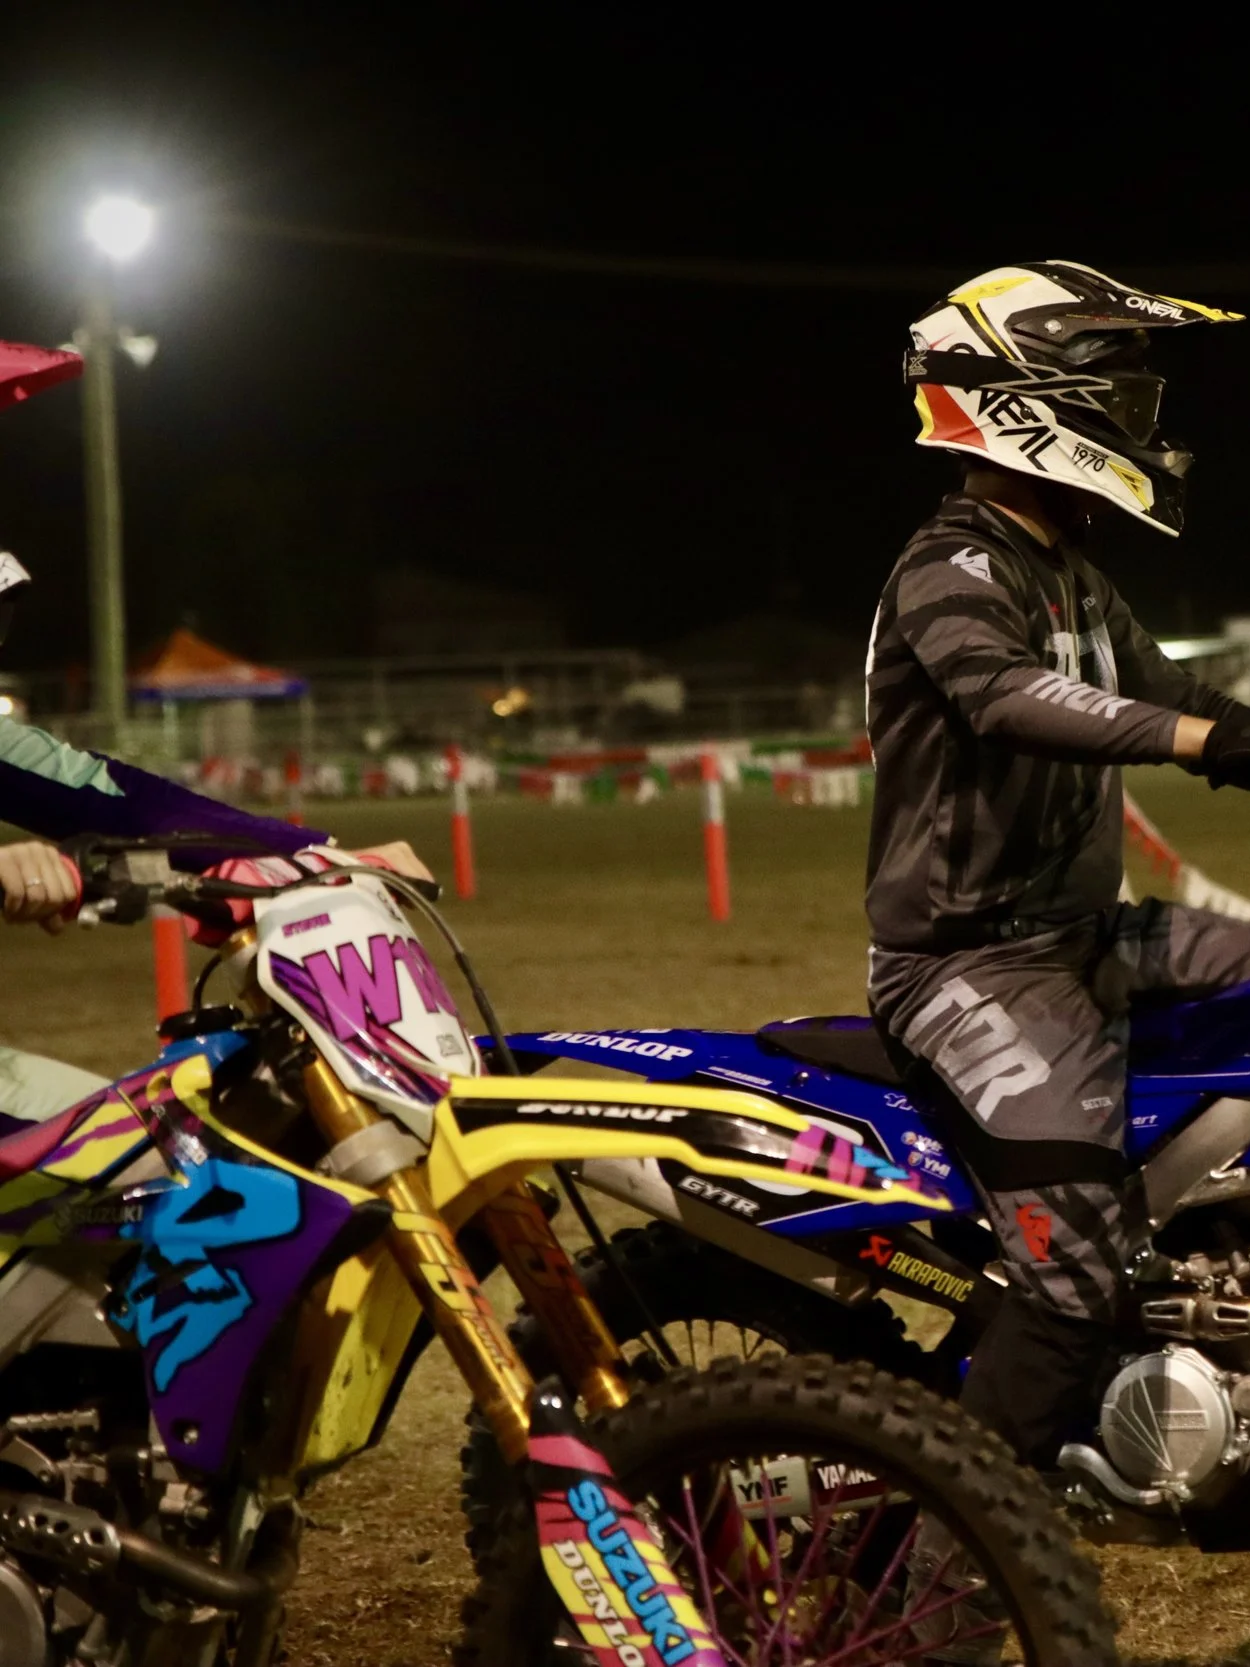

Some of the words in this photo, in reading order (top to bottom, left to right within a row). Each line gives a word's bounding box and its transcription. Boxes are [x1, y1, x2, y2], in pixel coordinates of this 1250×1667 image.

[1125, 296, 1186, 321] O'NEAL
[1071, 446, 1106, 472] 1970
[537, 1033, 693, 1061] DUNLOP
[678, 1175, 762, 1217] GYTR
[567, 1479, 697, 1666] SUZUKI
